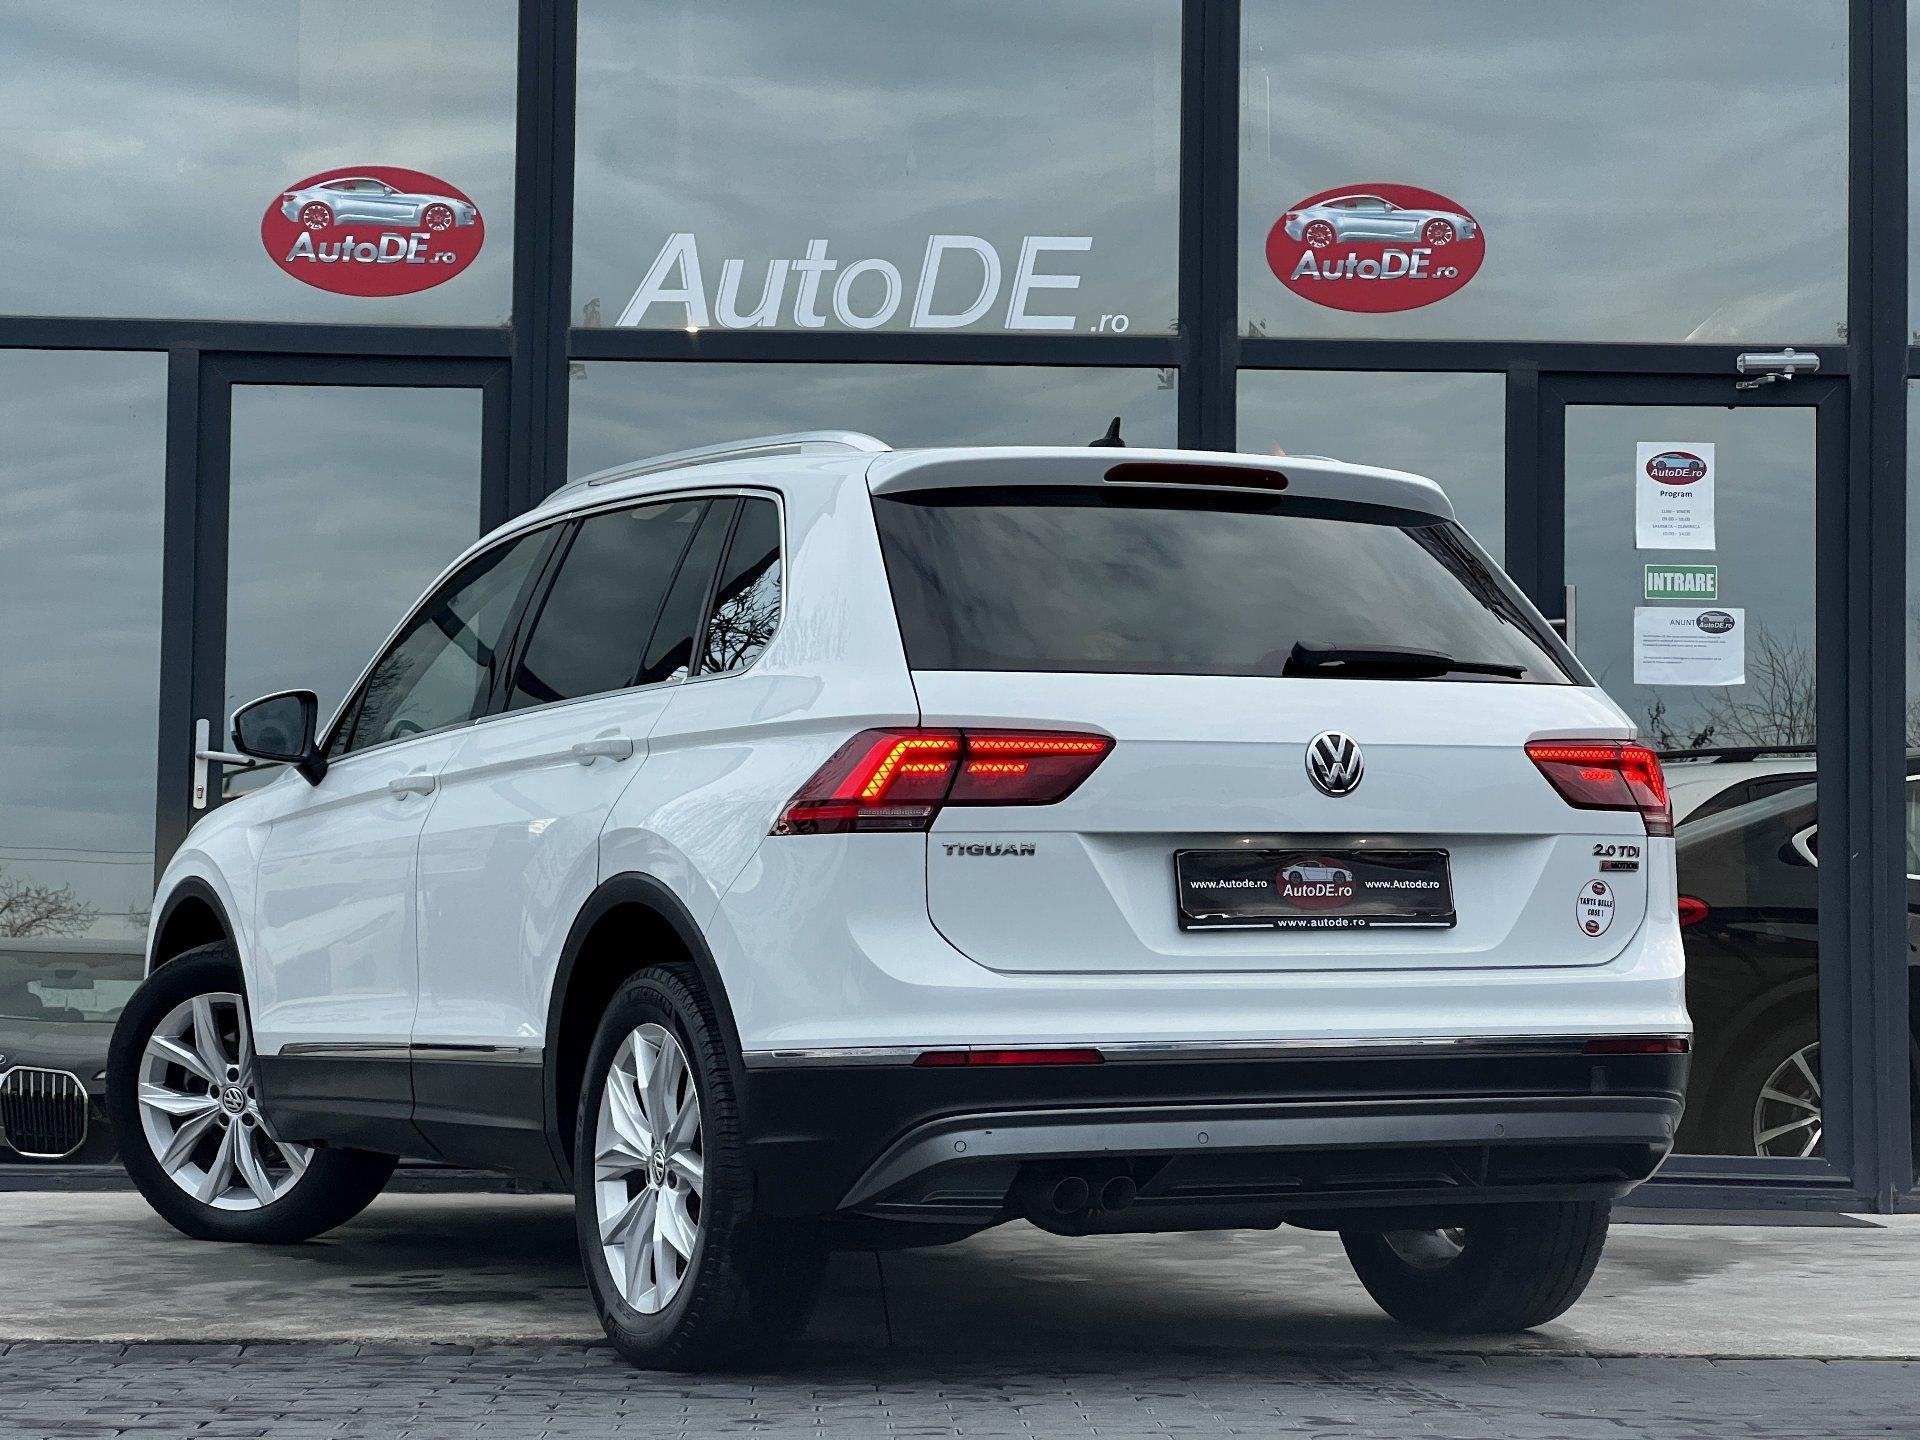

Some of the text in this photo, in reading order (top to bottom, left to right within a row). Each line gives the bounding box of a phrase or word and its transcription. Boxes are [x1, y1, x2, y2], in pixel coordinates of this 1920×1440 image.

[1651, 468, 1703, 477] AutoDE.ro
[1660, 490, 1693, 498] Program
[1647, 572, 1715, 592] INTRARE
[942, 842, 1036, 856] TIGUAN
[1617, 845, 1640, 859] TDI
[1190, 878, 1268, 889] www.Autode.ro
[1365, 879, 1440, 890] www.Autode.ro
[1283, 883, 1353, 897] AutoDE.ro
[1277, 917, 1366, 927] www.autode.ro
